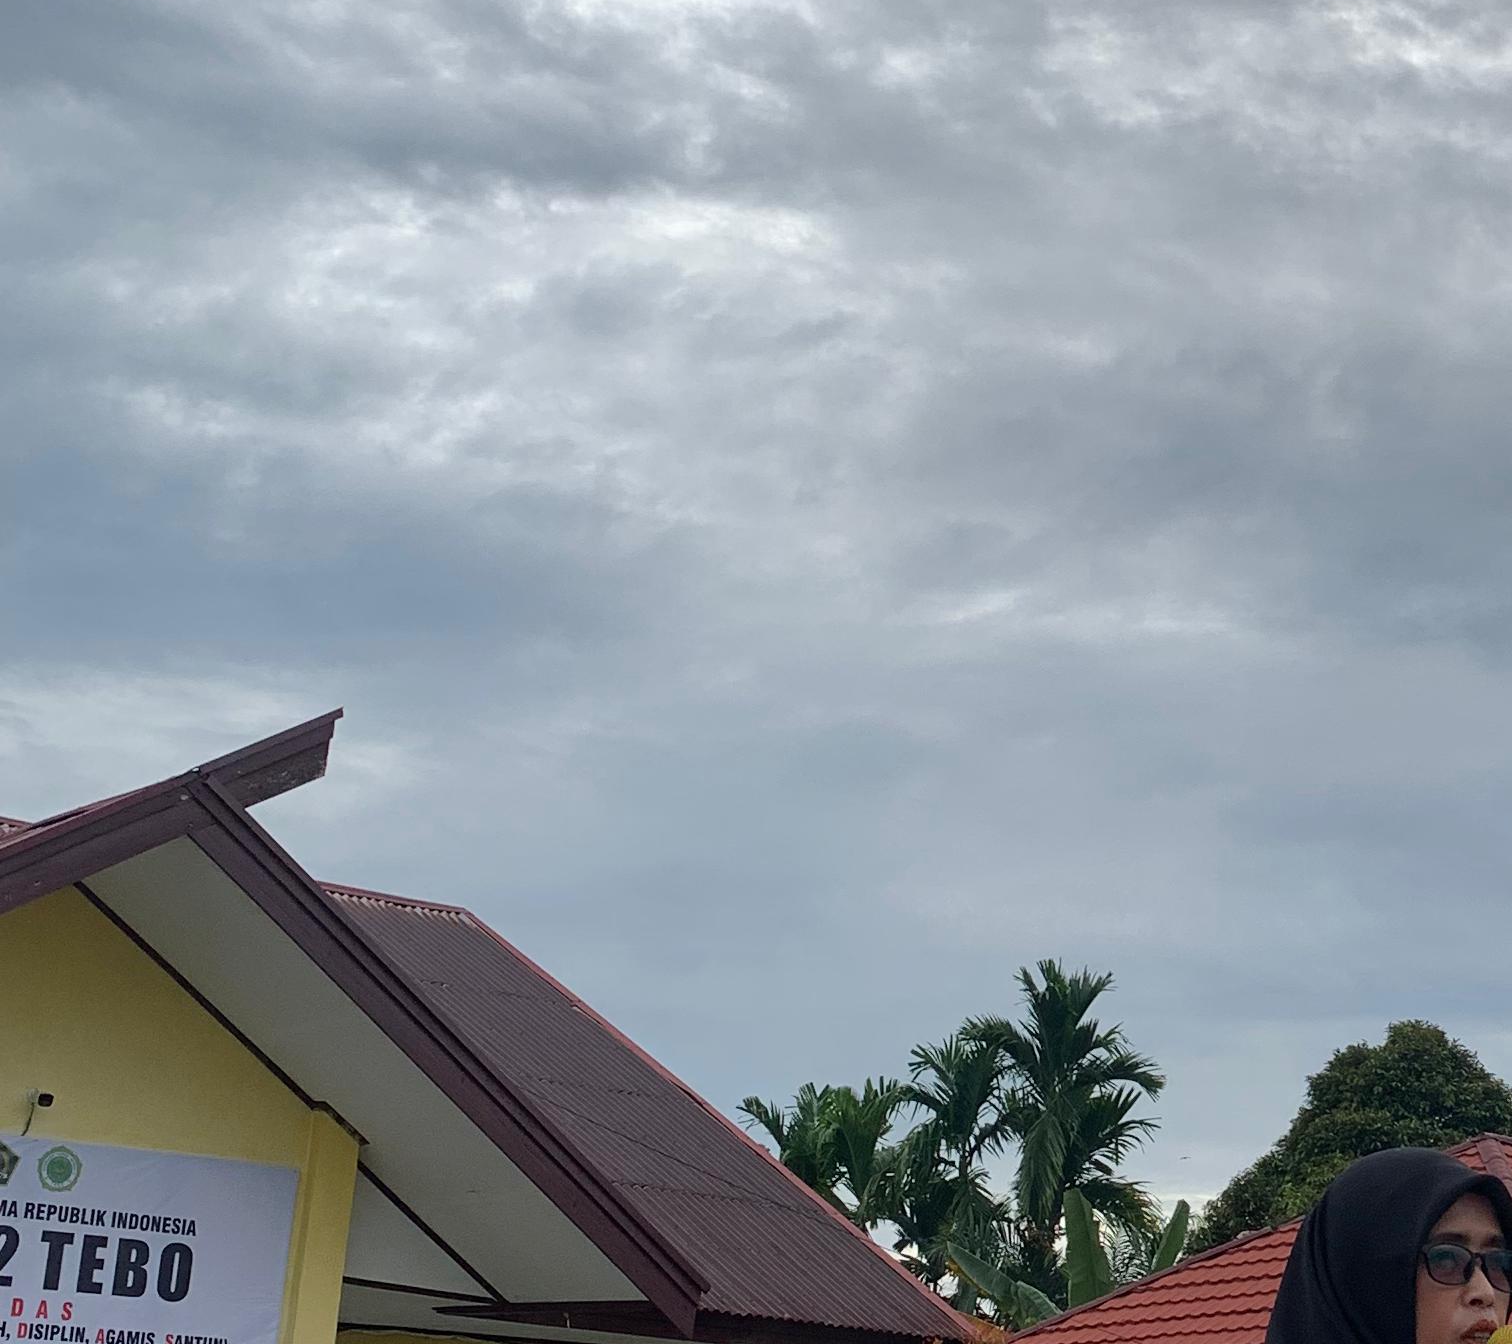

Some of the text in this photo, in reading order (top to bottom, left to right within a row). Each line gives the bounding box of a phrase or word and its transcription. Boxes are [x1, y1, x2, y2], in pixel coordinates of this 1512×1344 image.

[24, 1202, 107, 1227] REPUBLIK
[111, 1211, 197, 1236] INDONESIA
[0, 1225, 194, 1302] 2 TEBO
